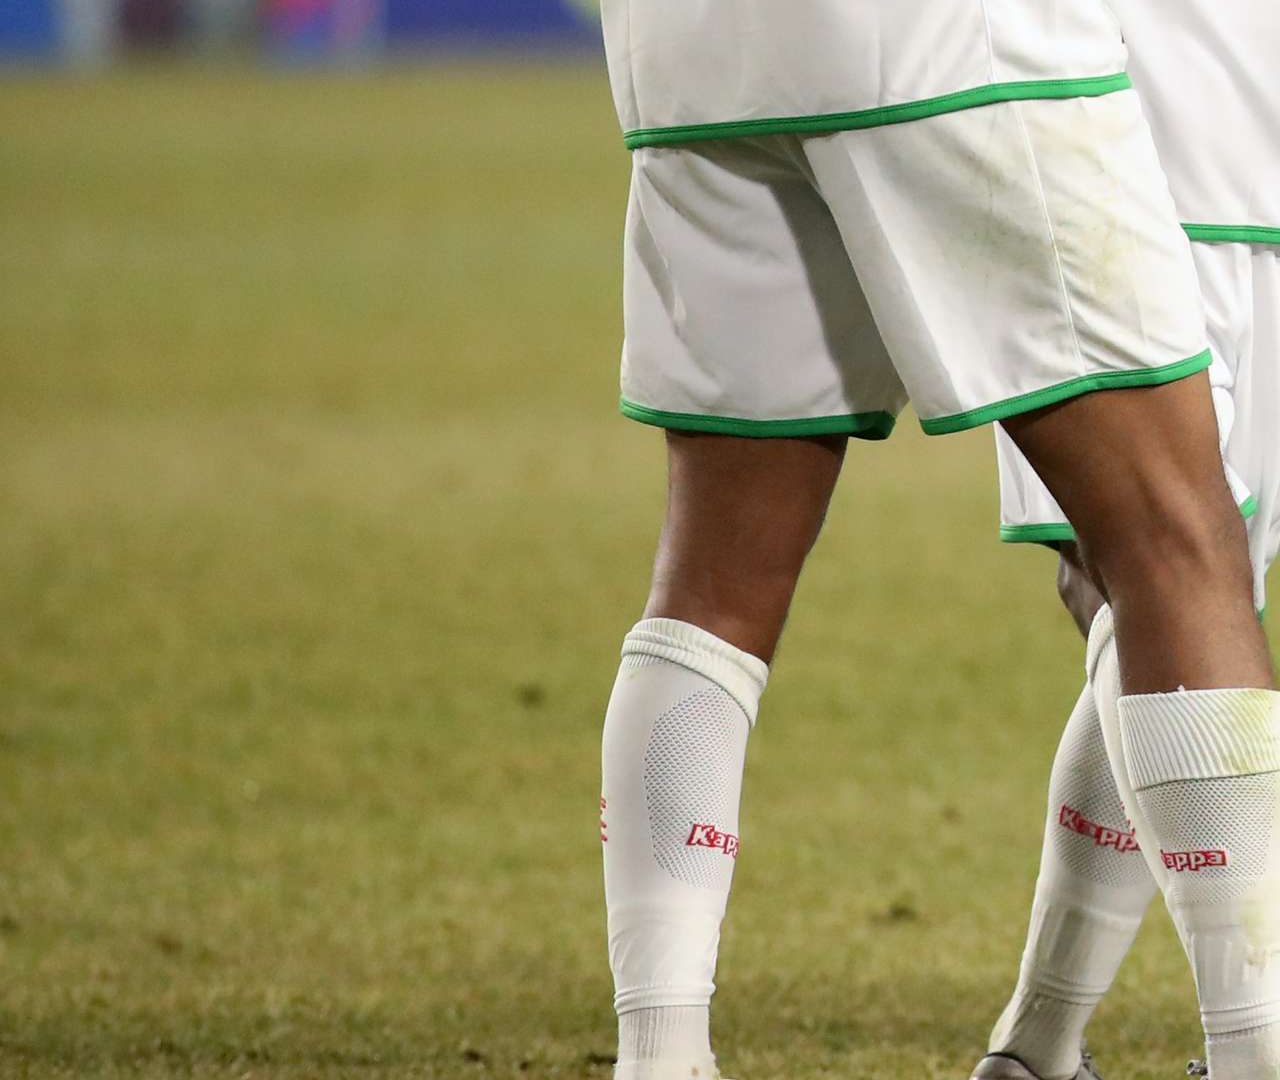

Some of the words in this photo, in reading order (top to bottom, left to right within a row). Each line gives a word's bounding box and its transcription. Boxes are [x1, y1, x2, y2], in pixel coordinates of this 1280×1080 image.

[686, 823, 740, 857] Kap
[1059, 805, 1141, 852] Kapp
[1161, 849, 1227, 871] appa
